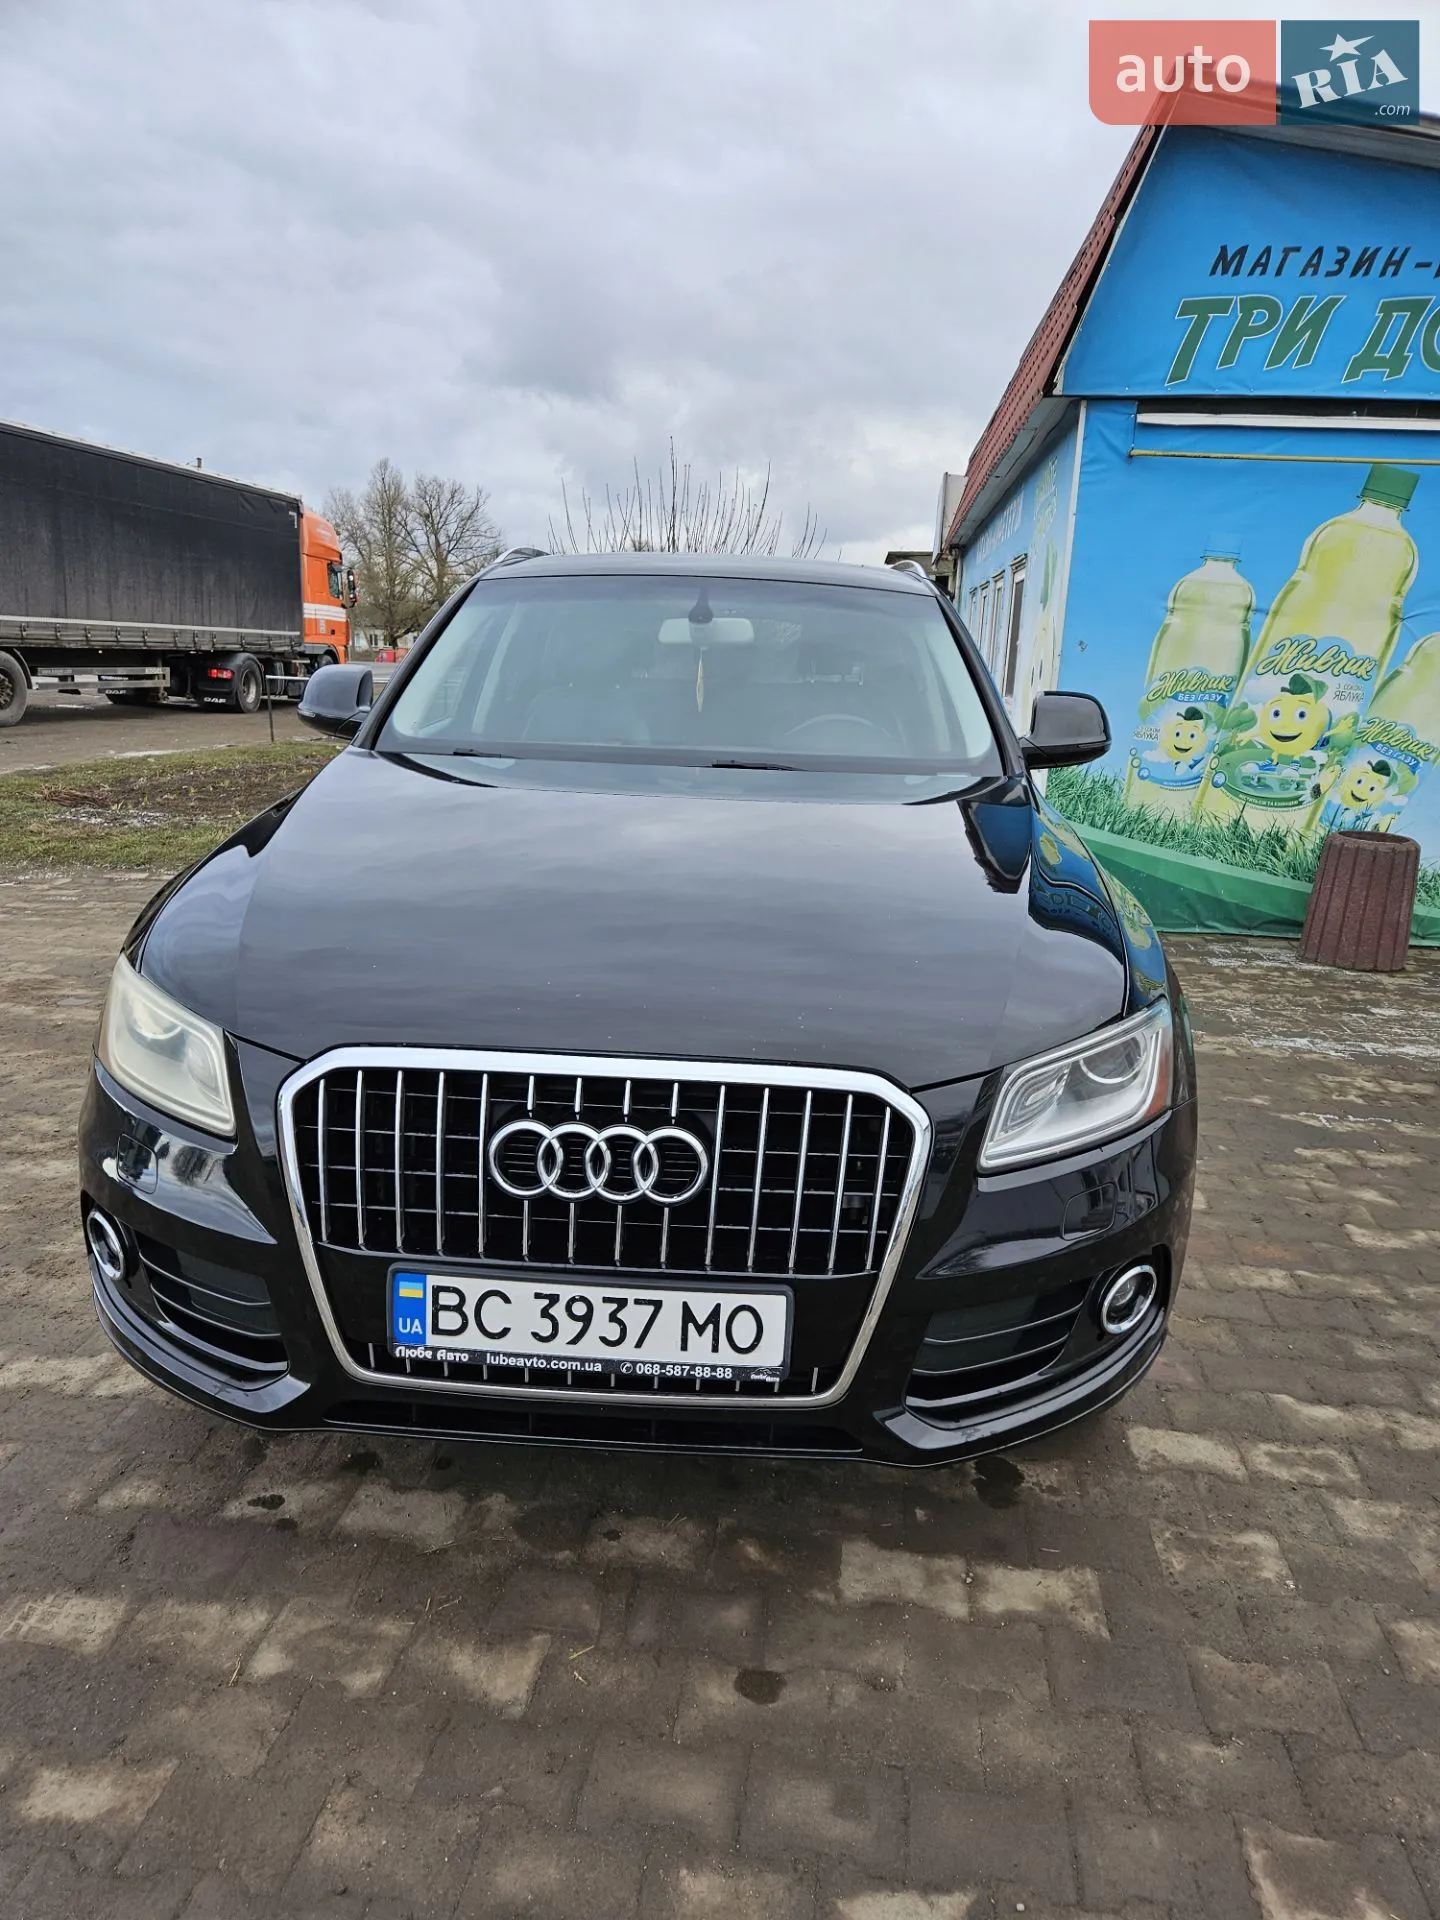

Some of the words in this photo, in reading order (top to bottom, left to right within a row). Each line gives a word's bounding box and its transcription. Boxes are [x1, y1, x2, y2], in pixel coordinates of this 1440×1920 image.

[1209, 244, 1440, 279] МАГАЗИН-
[1165, 294, 1347, 386] ТРИ
[1256, 637, 1378, 681] Живчик
[1146, 669, 1234, 702] Живчик
[1177, 693, 1196, 701] БЕЗ
[1198, 693, 1223, 702] ГАЗУ
[1353, 717, 1434, 761] Живчик
[1374, 743, 1393, 757] БЕЗ
[1392, 750, 1418, 766] ГАЗУ
[398, 1317, 423, 1335] UA
[431, 1285, 512, 1340] BC
[530, 1292, 663, 1349] 3937
[680, 1301, 764, 1355] MO
[436, 1349, 469, 1362] Авто
[486, 1352, 602, 1373] lubeavto.com.ua
[635, 1363, 733, 1380] 068-587-88-88
